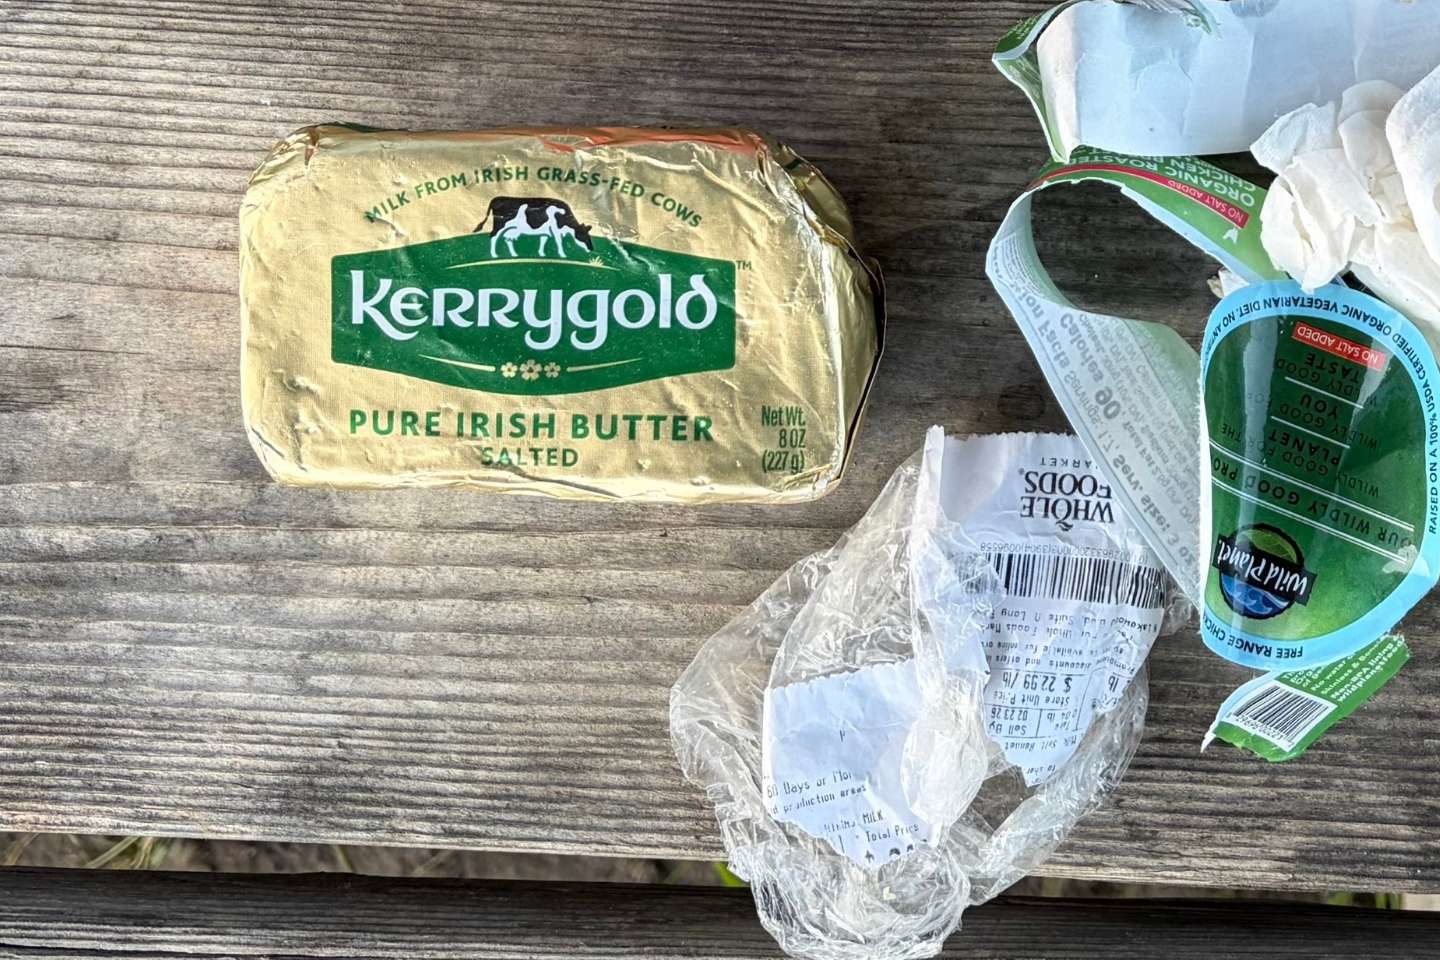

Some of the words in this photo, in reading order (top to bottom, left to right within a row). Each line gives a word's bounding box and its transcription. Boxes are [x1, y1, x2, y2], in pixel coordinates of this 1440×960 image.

[363, 191, 411, 223] MILK
[415, 172, 467, 199] FROM
[474, 166, 529, 184] IRISH
[537, 166, 645, 198] GRASS-FED
[651, 192, 703, 228] COWS
[1165, 165, 1255, 207] ORGANIC
[1205, 196, 1228, 216] SALT
[1226, 207, 1244, 224] NO
[350, 269, 718, 351] Kerrygold
[1235, 302, 1261, 318] DIET.
[1262, 295, 1338, 312] VEGETARIAN
[1221, 313, 1236, 328] NO
[1342, 304, 1392, 336] ORGANIC
[1296, 326, 1336, 346] ADDED
[1335, 341, 1361, 358] SALT
[1361, 349, 1379, 364] NO
[1391, 332, 1426, 380] CERTIFIED
[1305, 352, 1360, 383] TASTE
[1300, 393, 1340, 418] YOU
[1423, 377, 1436, 415] USDA
[349, 409, 442, 438] PURE
[456, 411, 557, 440] IRISH
[570, 413, 715, 442] BUTTER
[761, 405, 783, 427] Net
[785, 405, 806, 427] Wt.
[779, 428, 787, 449] 8
[1430, 414, 1438, 447] 100%
[481, 446, 580, 468] SALTED
[1267, 428, 1341, 467] PLANET
[1430, 448, 1438, 458] A
[761, 449, 789, 474] (227
[790, 449, 805, 476] g)
[1039, 457, 1098, 469] ARKET
[1430, 461, 1438, 484] ON
[1023, 470, 1113, 500] FOODS
[1244, 474, 1300, 505] GOOD
[1020, 496, 1115, 527] WHOLE
[1307, 502, 1370, 535] WILDLY
[1428, 490, 1439, 535] RAISED
[1266, 563, 1308, 595] Wild
[1229, 635, 1272, 657] RANGE
[1276, 644, 1304, 658] FREE
[1023, 674, 1057, 692] 22.99
[1063, 676, 1073, 693] $
[992, 690, 1017, 704] Pice
[1021, 693, 1040, 706] Unit
